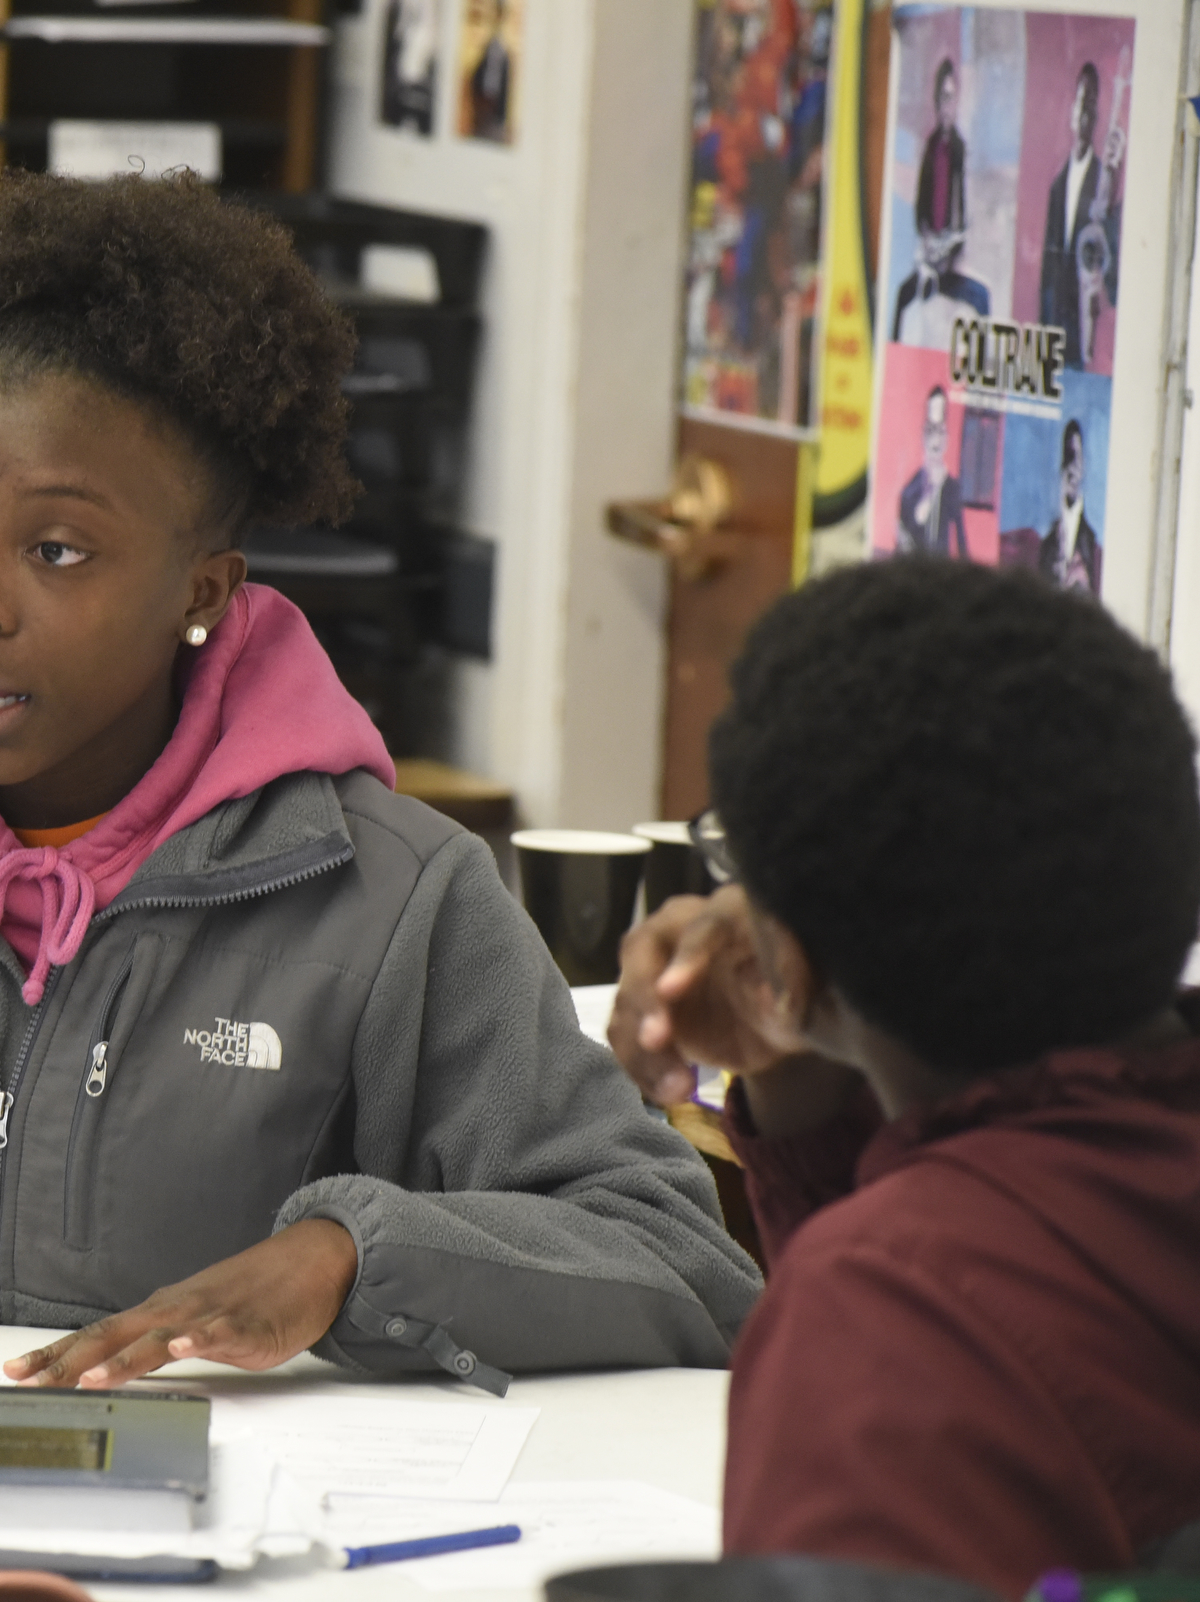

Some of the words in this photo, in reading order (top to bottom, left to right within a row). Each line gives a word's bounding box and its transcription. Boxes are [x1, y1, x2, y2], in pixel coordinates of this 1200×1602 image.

[951, 317, 1065, 399] COLTRANE
[214, 1016, 249, 1038] THE
[183, 1028, 249, 1052] NORTH
[200, 1046, 247, 1067] FACE
